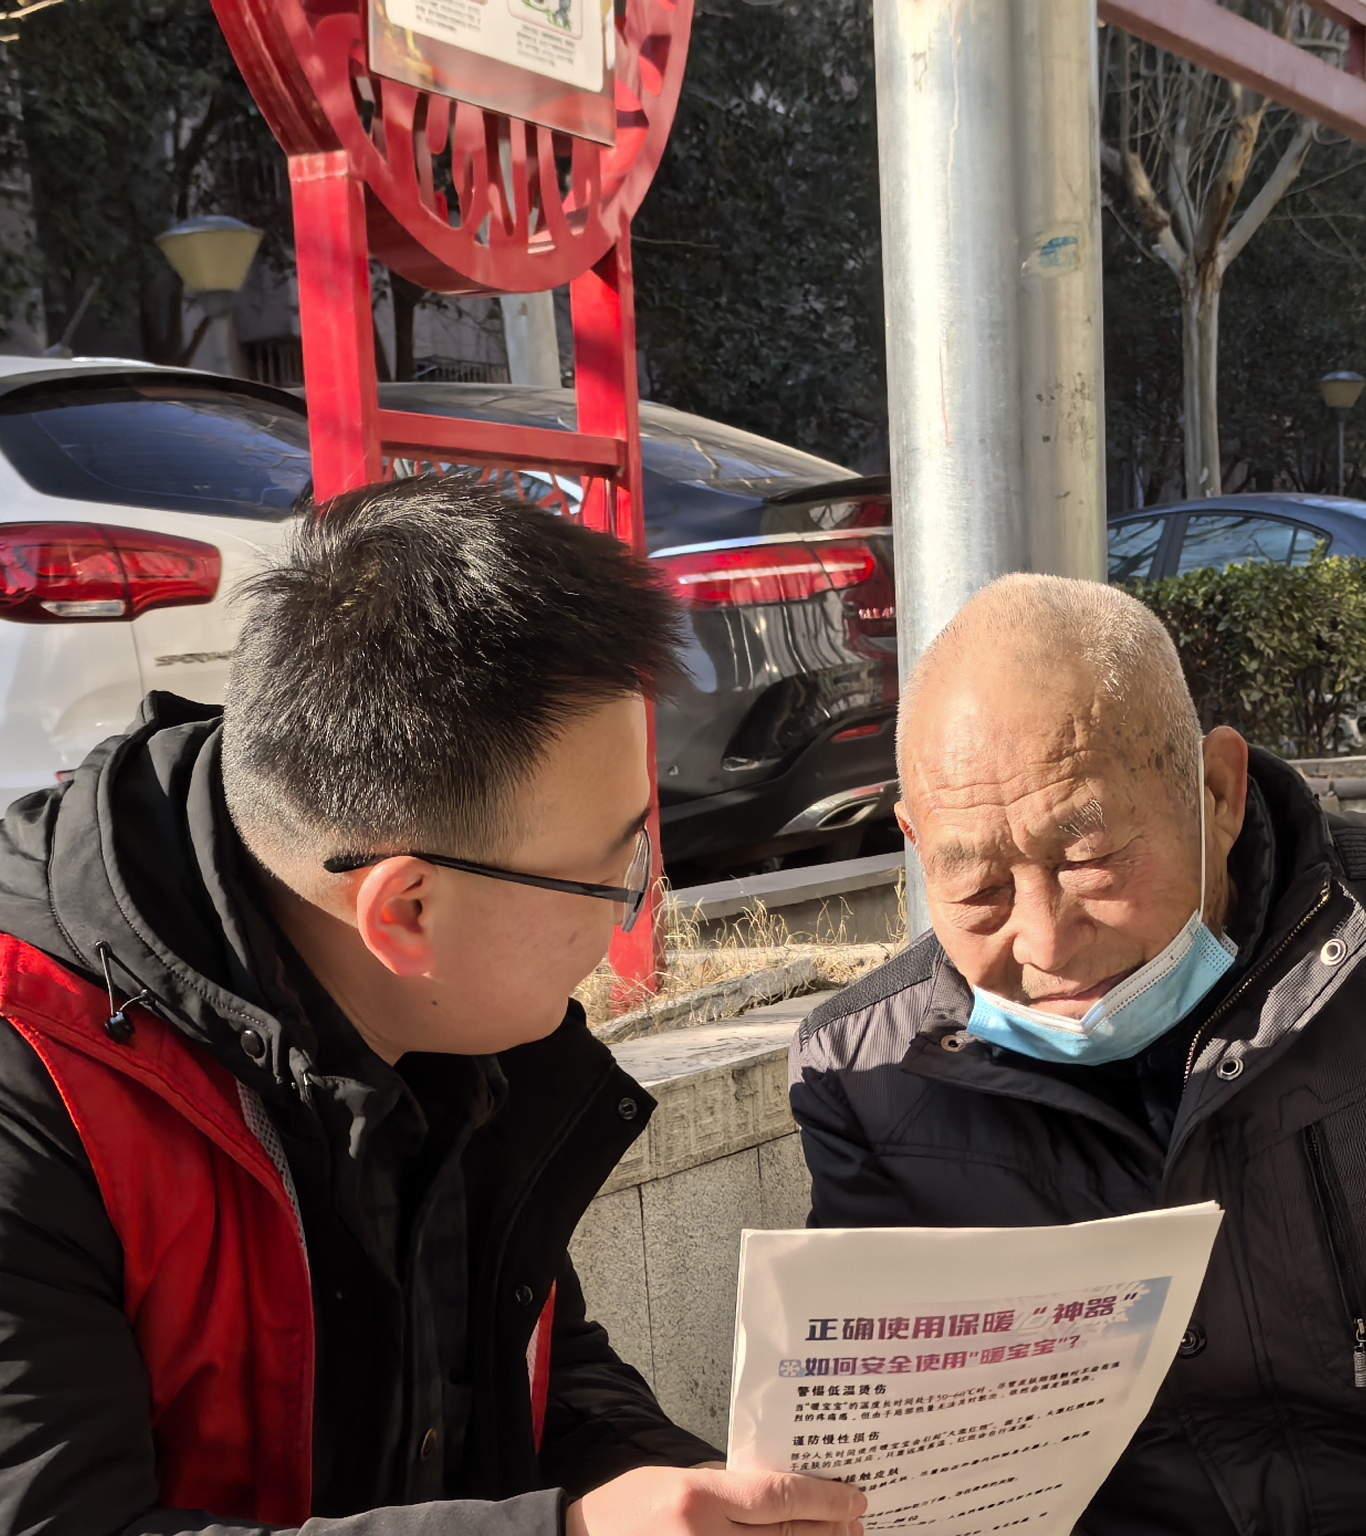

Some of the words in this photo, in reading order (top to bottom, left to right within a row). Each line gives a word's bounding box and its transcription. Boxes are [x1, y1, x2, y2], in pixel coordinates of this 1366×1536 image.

[792, 1431, 880, 1446] 谨防慢性损伤
